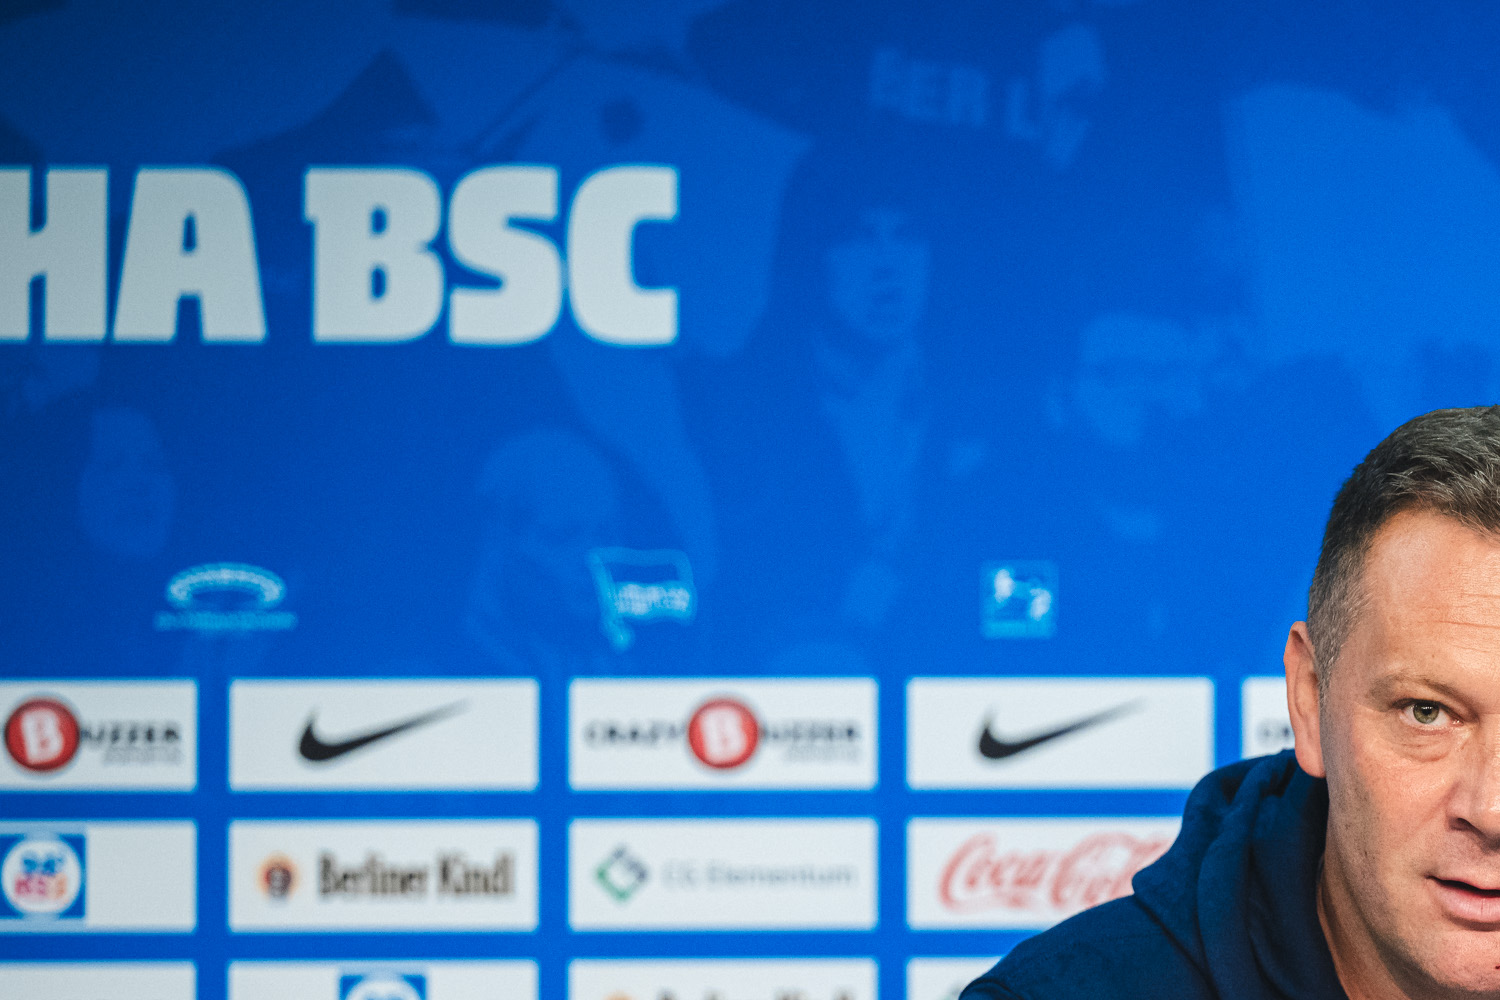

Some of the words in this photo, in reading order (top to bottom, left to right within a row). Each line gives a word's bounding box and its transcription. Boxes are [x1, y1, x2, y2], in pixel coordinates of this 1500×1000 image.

[305, 165, 678, 344] BSC
[318, 852, 428, 898] Berliner
[438, 851, 514, 898] Kindl
